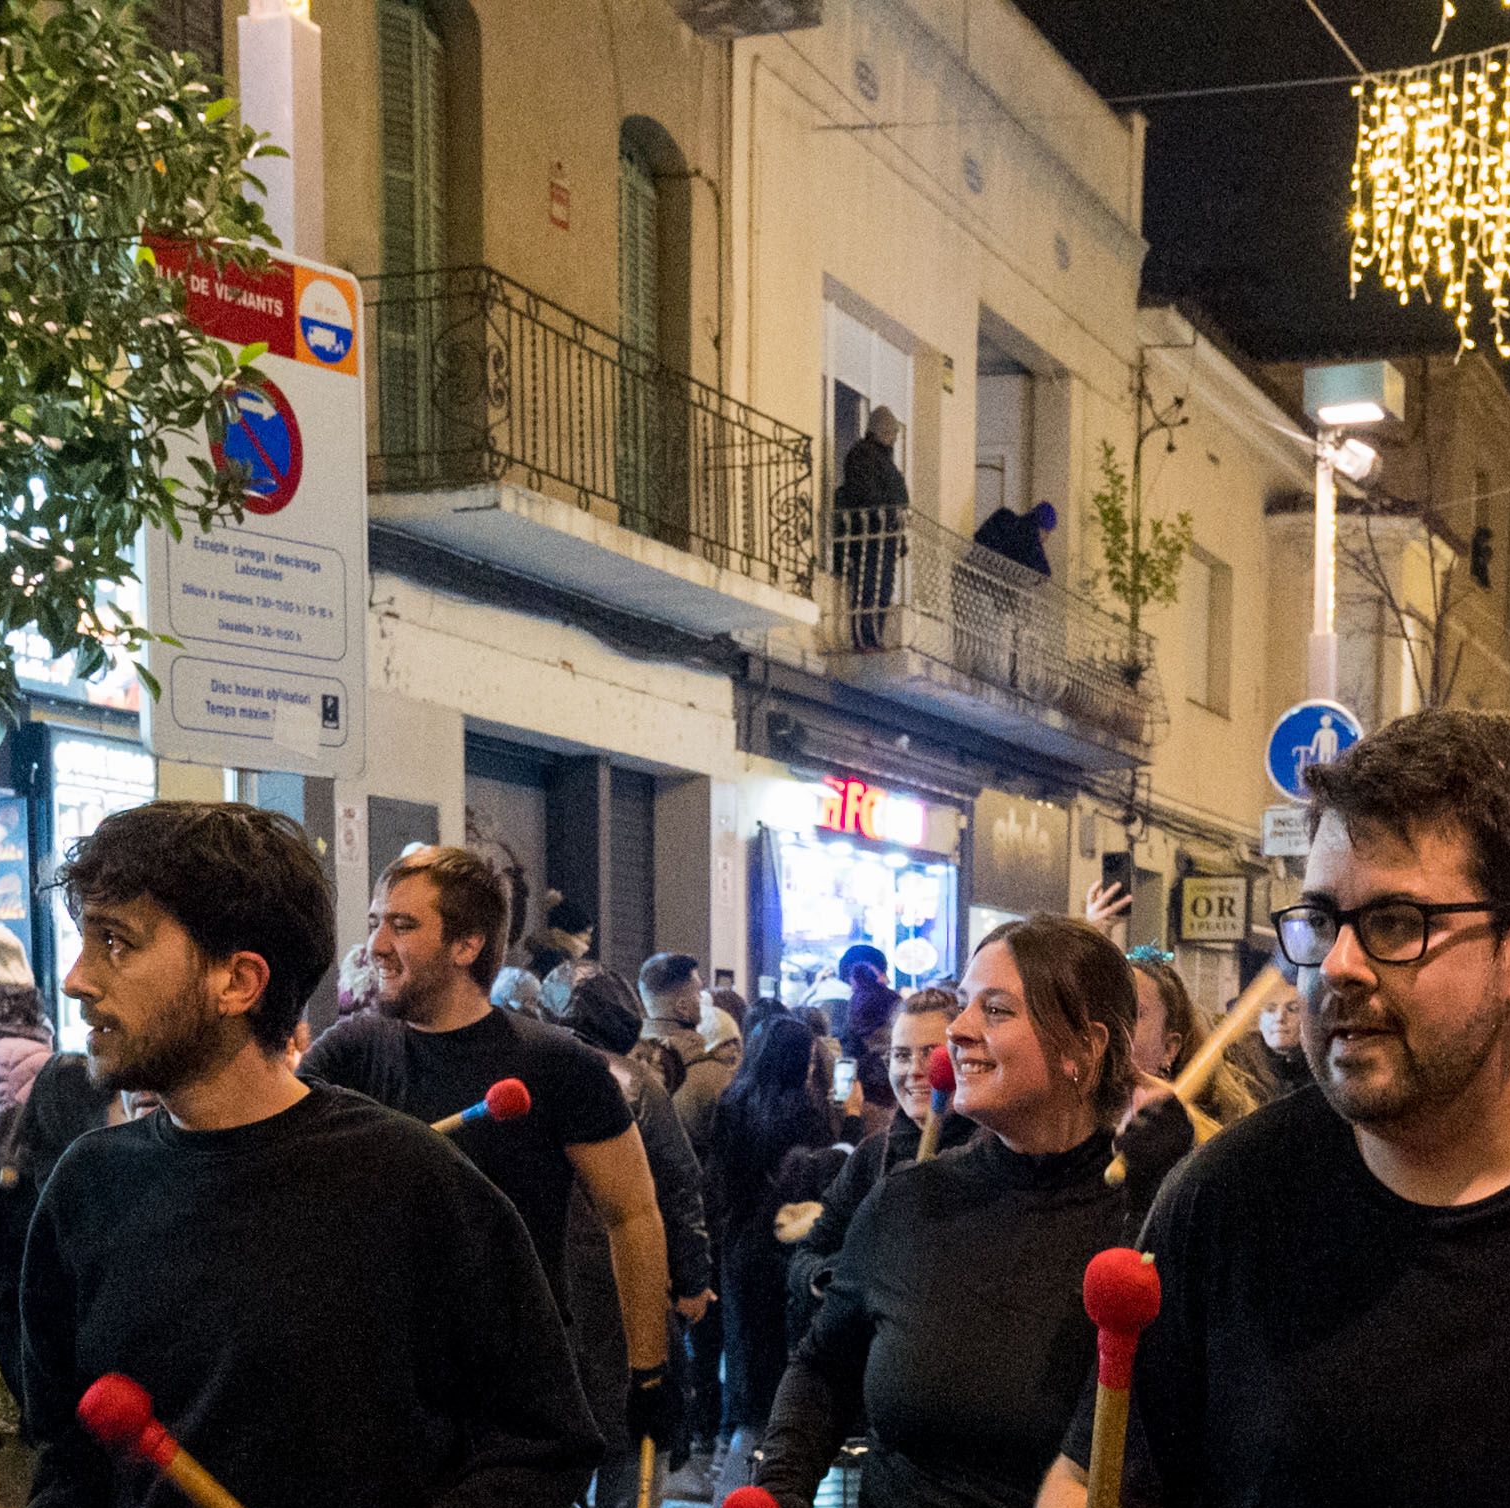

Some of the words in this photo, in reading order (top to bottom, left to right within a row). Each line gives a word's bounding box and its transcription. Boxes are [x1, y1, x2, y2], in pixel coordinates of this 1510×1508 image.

[190, 274, 210, 297] DE
[211, 678, 233, 694] Disc
[235, 681, 264, 700] horari
[205, 700, 236, 718] Temps
[1190, 895, 1237, 919] OR
